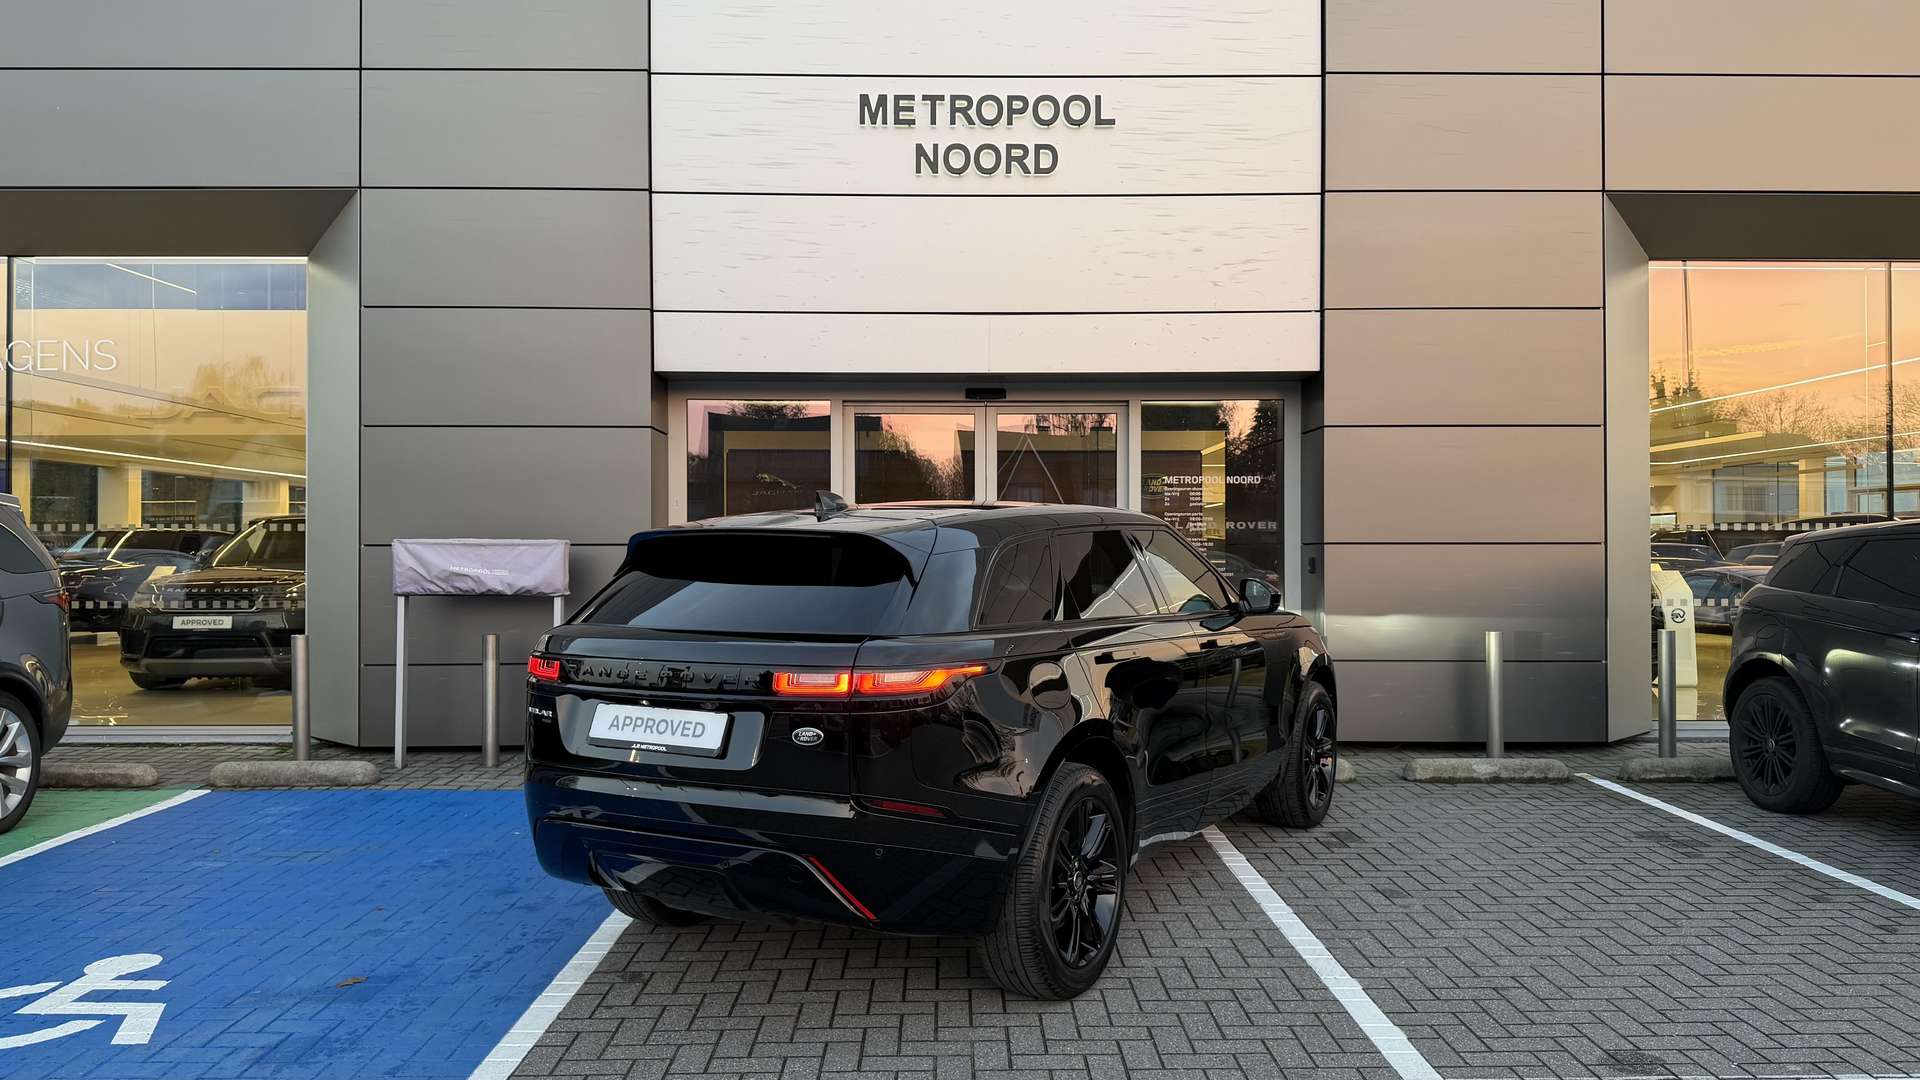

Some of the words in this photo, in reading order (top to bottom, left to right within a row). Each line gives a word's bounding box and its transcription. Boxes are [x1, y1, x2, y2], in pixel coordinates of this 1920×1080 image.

[859, 94, 1116, 127] METROPOOL
[915, 143, 1059, 175] NOORD
[1163, 475, 1222, 484] METROPOOL
[1226, 475, 1261, 484] NOORD
[1226, 521, 1278, 530] ROVER
[568, 662, 649, 681] RANGE
[608, 715, 706, 738] APPROVED
[640, 744, 667, 752] METROPOOL
